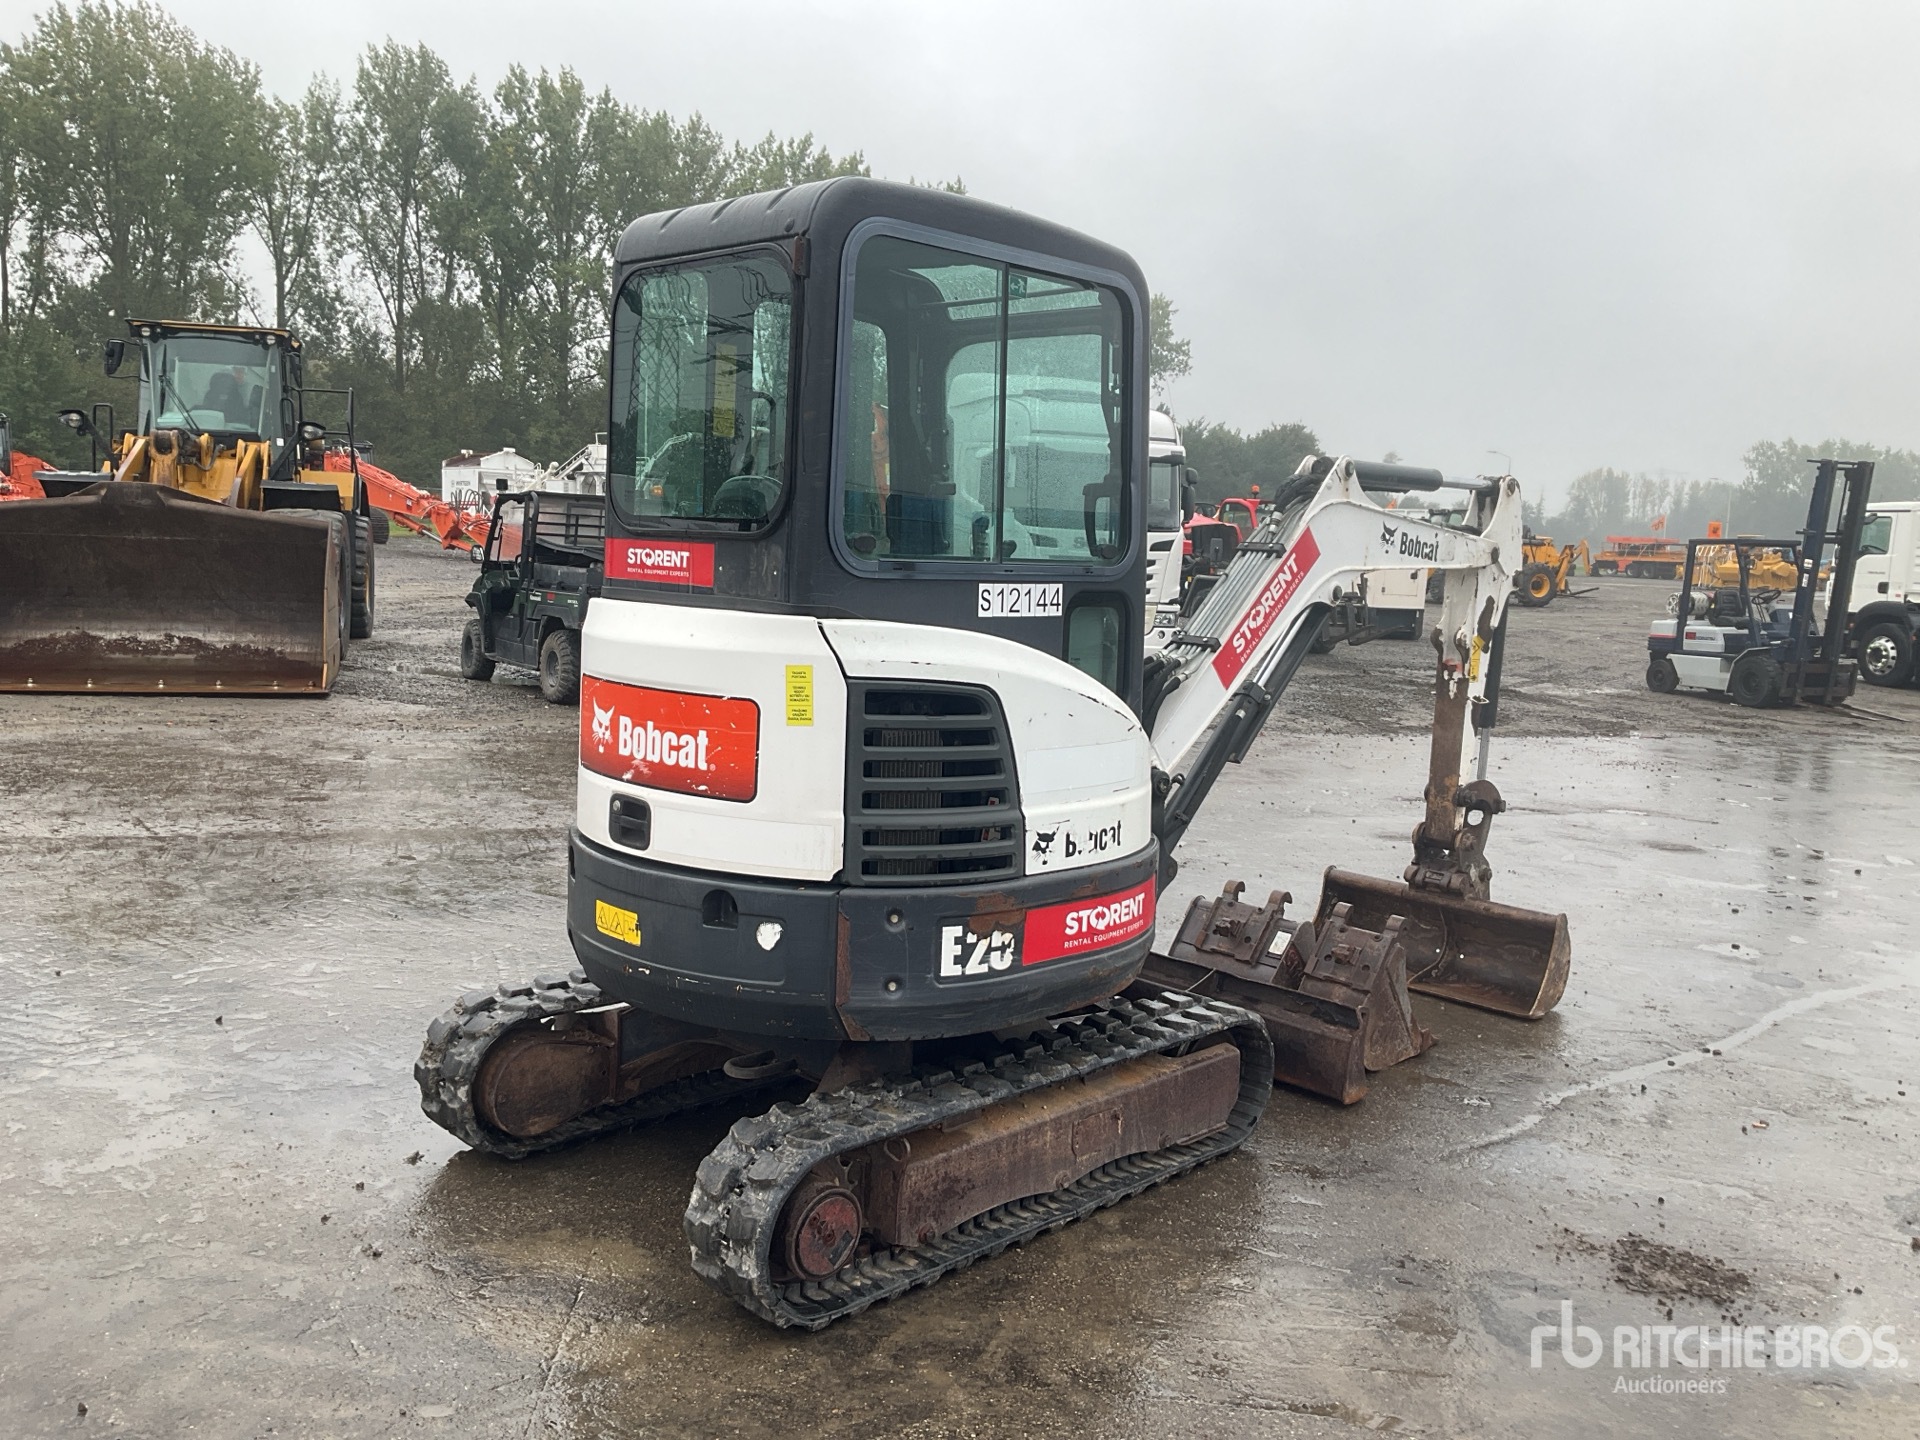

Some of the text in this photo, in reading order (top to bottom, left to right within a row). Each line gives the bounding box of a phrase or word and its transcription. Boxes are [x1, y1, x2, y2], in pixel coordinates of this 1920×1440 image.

[627, 547, 690, 568] STORENT
[1399, 532, 1439, 563] Bobcat
[644, 568, 669, 576] EQUIPMENT
[980, 587, 1062, 613] S12144
[1232, 552, 1298, 654] STORENT
[1240, 570, 1305, 663] RENTAL EQUIPMENT EXPERTS
[618, 714, 709, 771] Bobcat
[1064, 892, 1145, 935] STORENT
[1064, 919, 1144, 949] RENTAL EQUIPMENT EXPERTS
